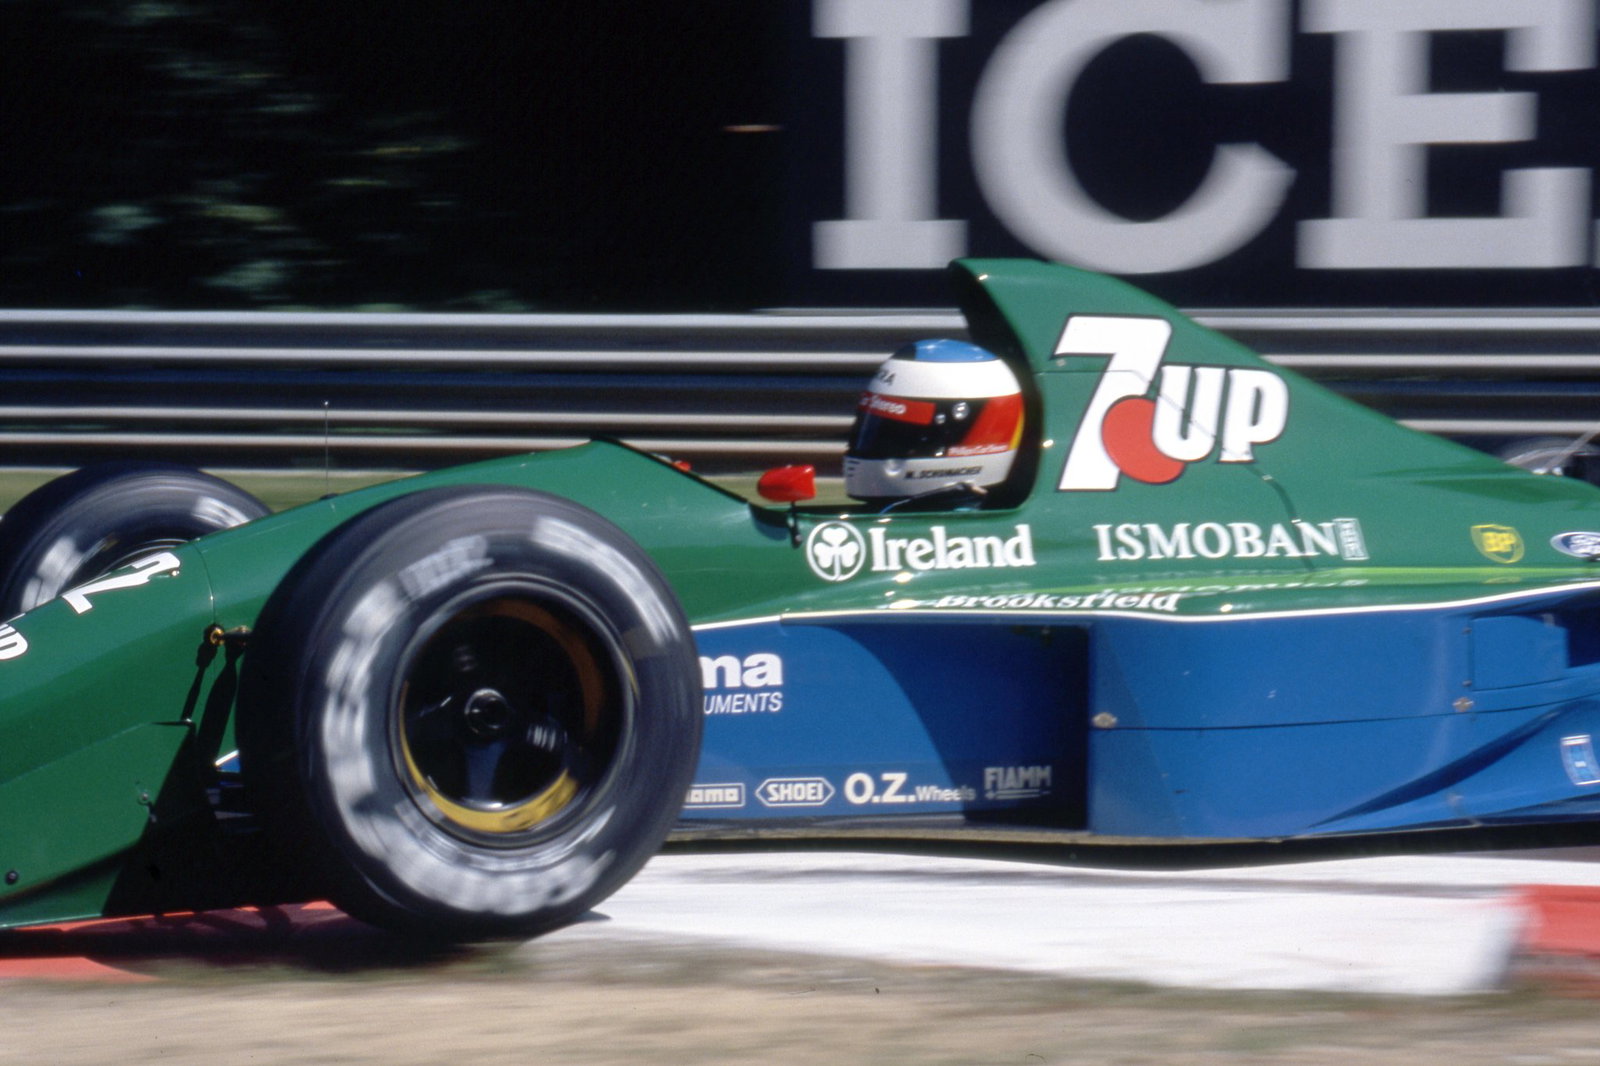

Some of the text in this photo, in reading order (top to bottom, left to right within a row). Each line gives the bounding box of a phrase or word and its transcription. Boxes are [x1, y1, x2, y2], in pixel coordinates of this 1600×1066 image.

[868, 524, 1036, 571] Ireland
[1092, 522, 1339, 560] ISMOBAN
[933, 588, 1180, 612] Brooksfield
[703, 691, 784, 715] UMENTS
[983, 764, 1052, 791] FIAMM
[766, 782, 824, 802] SHOEI
